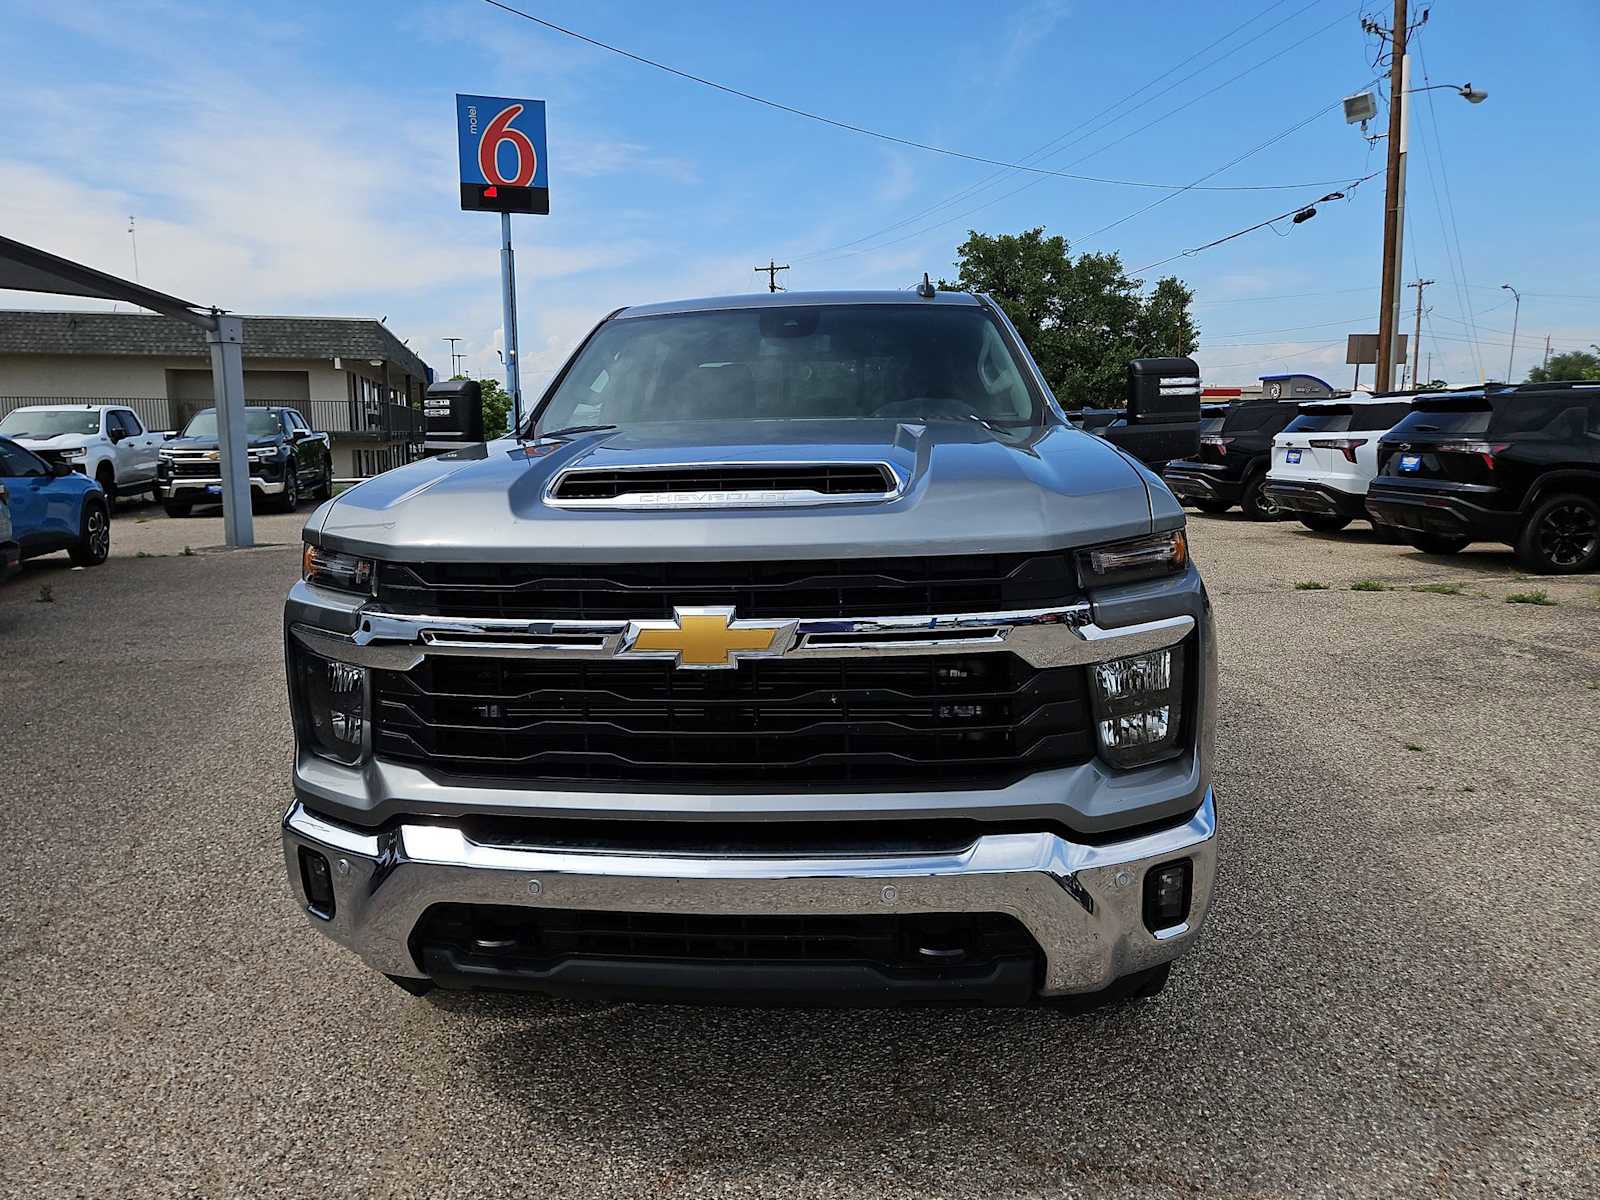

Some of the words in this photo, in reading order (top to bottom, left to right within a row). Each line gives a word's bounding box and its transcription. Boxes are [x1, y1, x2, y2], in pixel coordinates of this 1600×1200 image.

[467, 105, 478, 135] motel
[478, 103, 537, 187] 6
[639, 491, 791, 507] CHEVROLET
